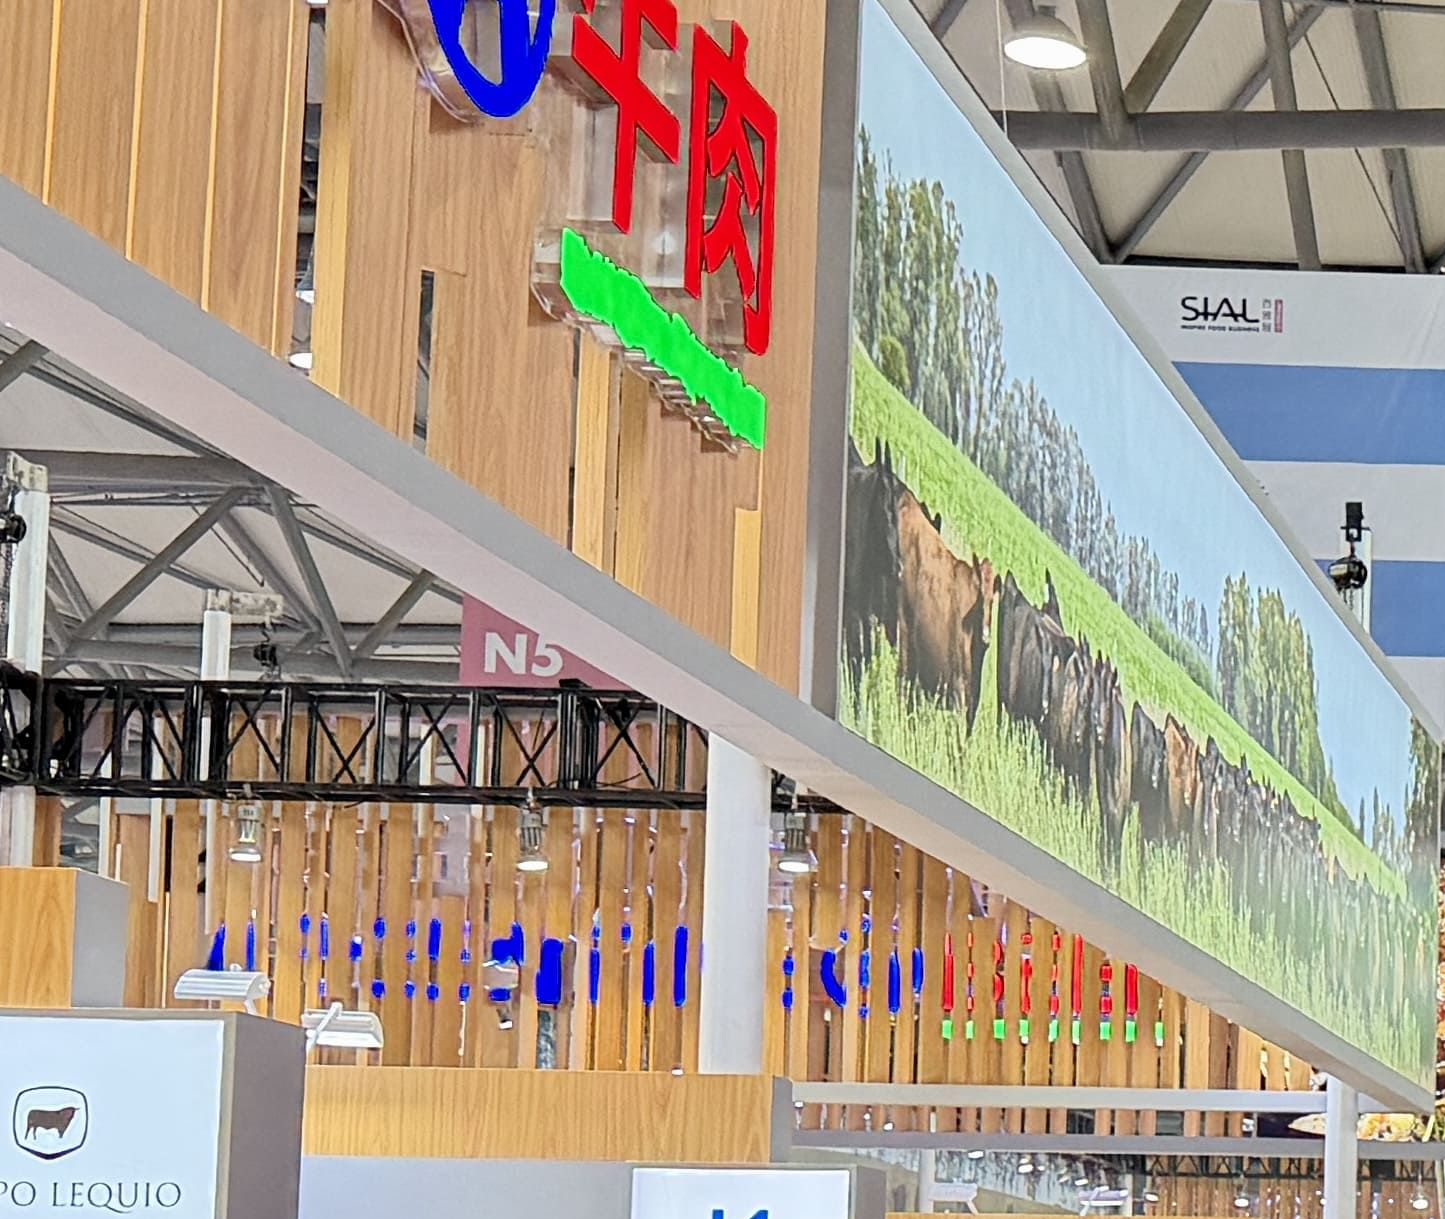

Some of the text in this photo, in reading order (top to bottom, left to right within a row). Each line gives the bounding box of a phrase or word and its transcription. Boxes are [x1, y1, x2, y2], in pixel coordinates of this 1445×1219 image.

[1180, 296, 1260, 323] SIAL
[484, 631, 564, 677] N5
[52, 1181, 182, 1214] LEQUIO
